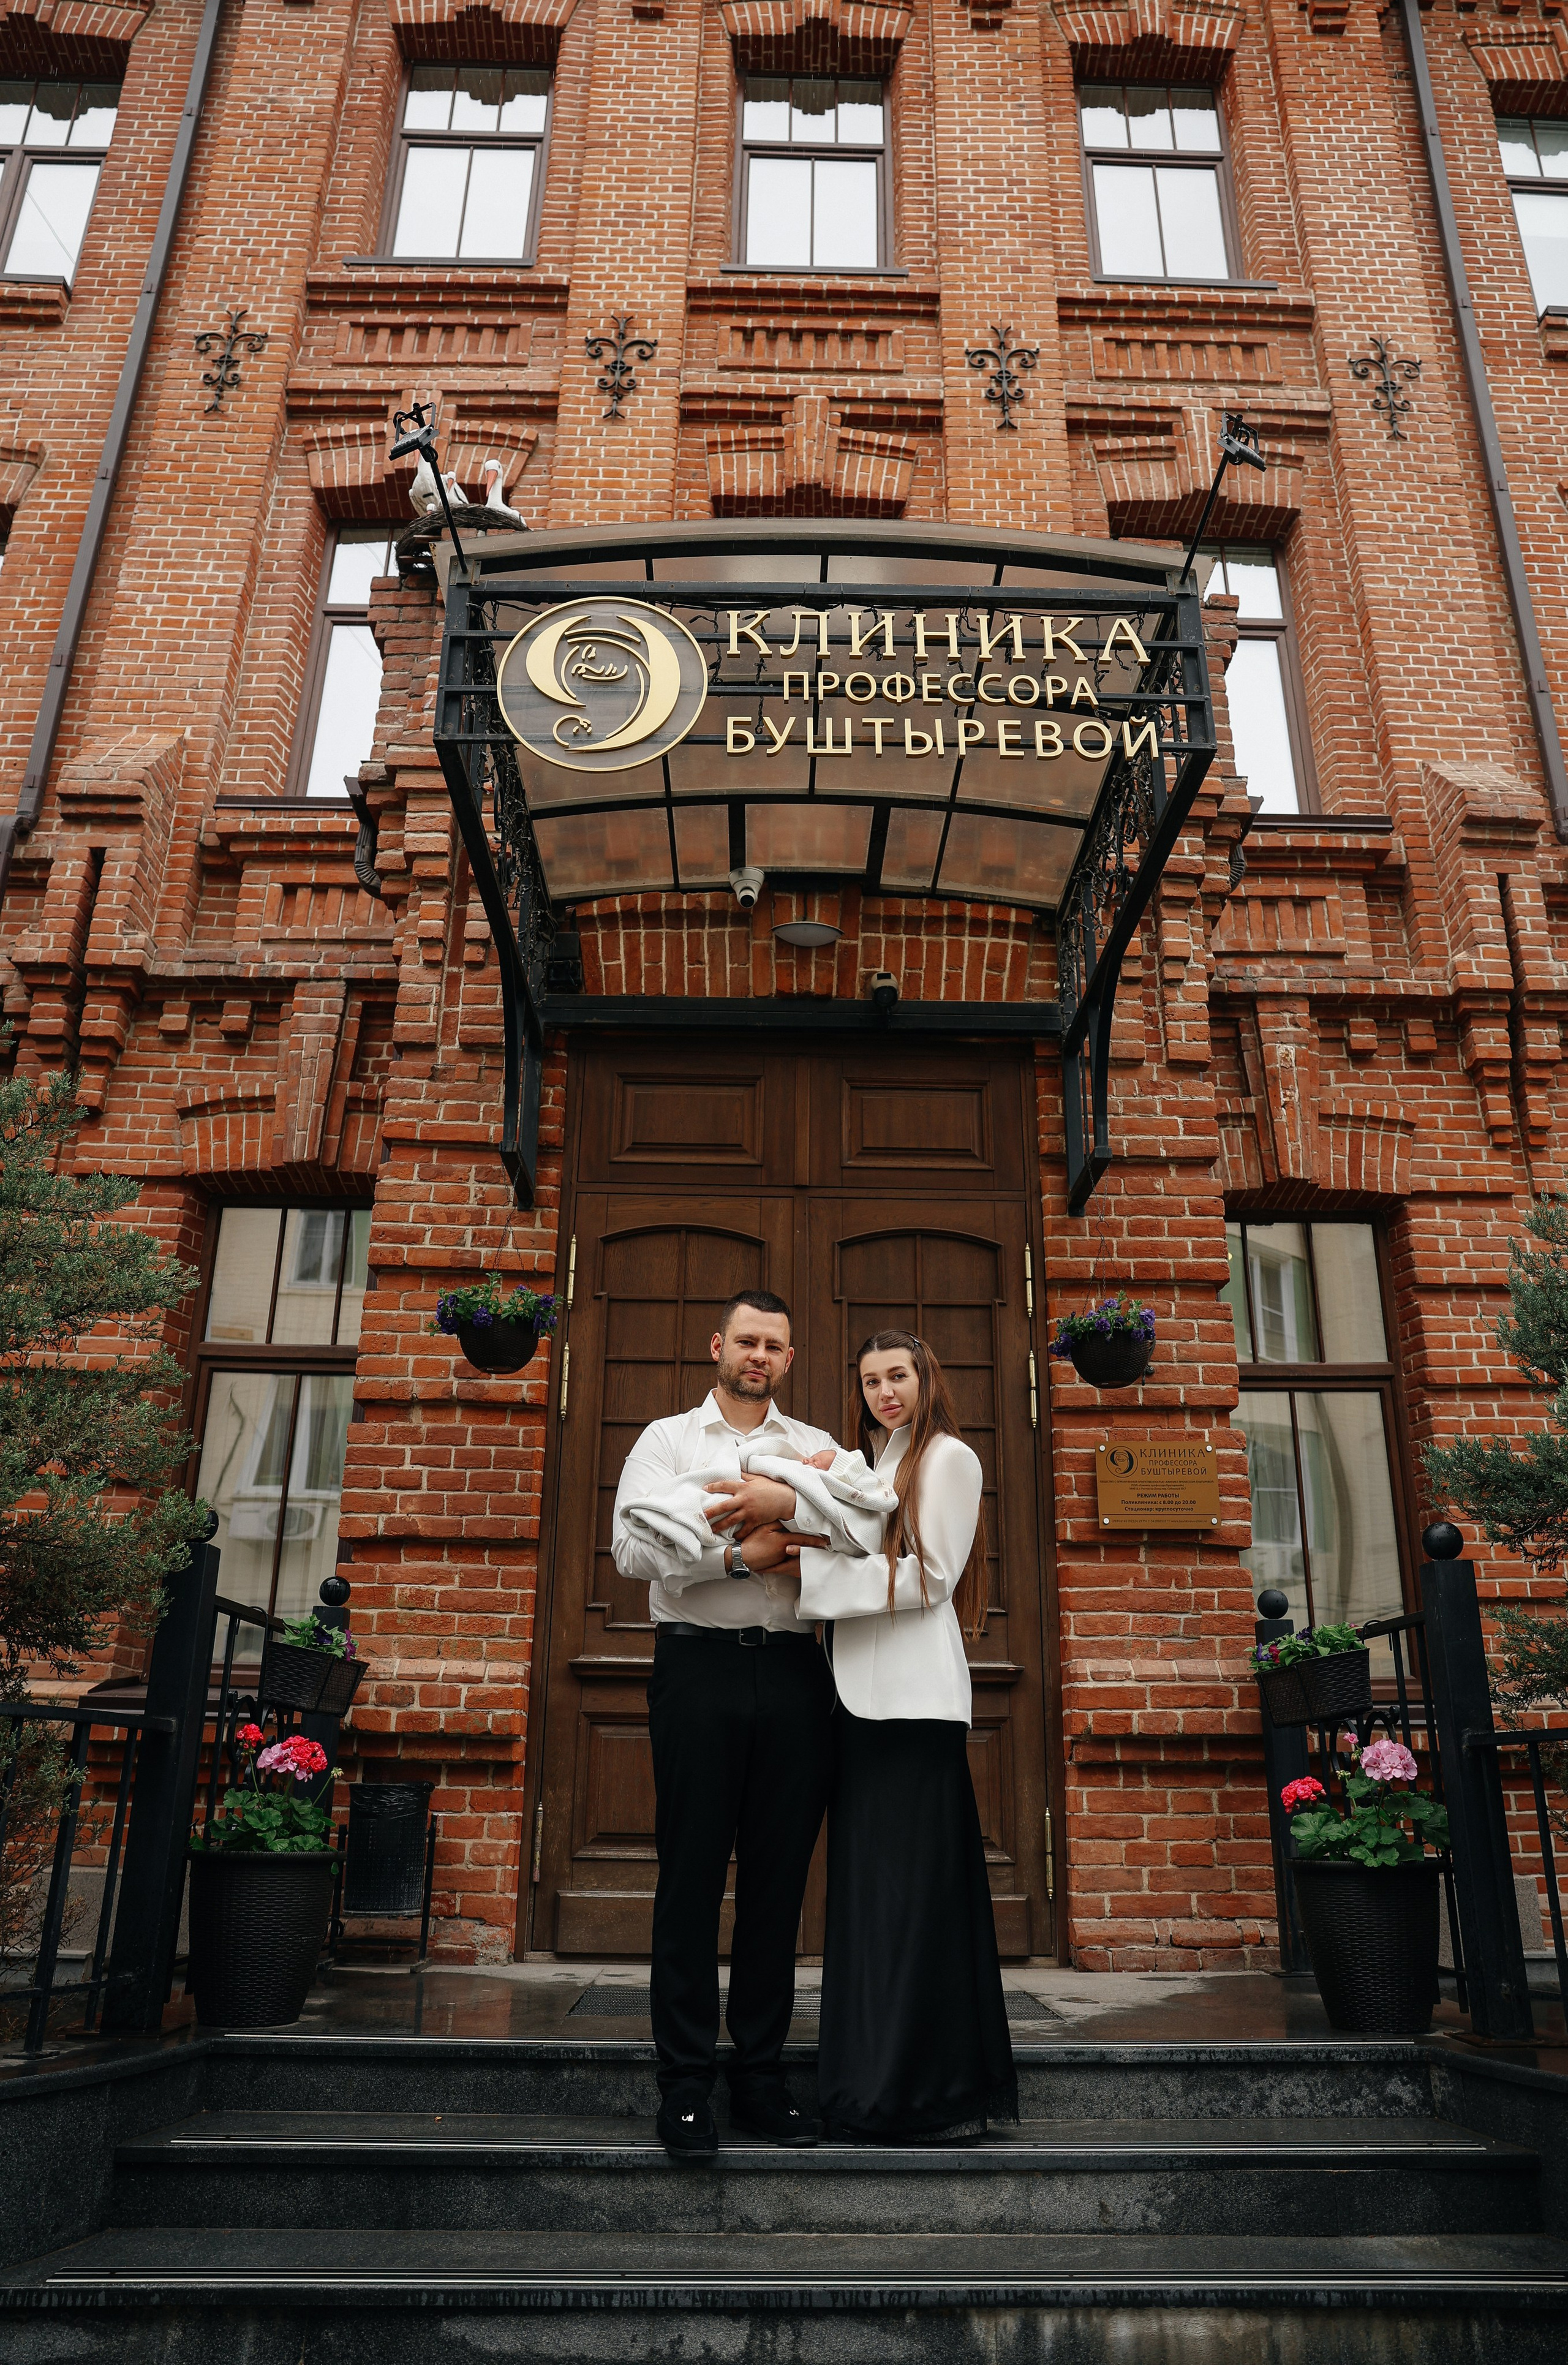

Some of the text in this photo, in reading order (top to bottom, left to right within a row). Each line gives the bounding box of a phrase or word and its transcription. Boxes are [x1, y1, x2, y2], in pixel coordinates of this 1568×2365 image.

[726, 611, 1151, 666] КЛИНИКА
[783, 671, 1099, 709] ПРОФЕССОРА
[726, 716, 1159, 761] БУШТЫРЕВОЙ
[1140, 1449, 1205, 1458] КЛИНИКА
